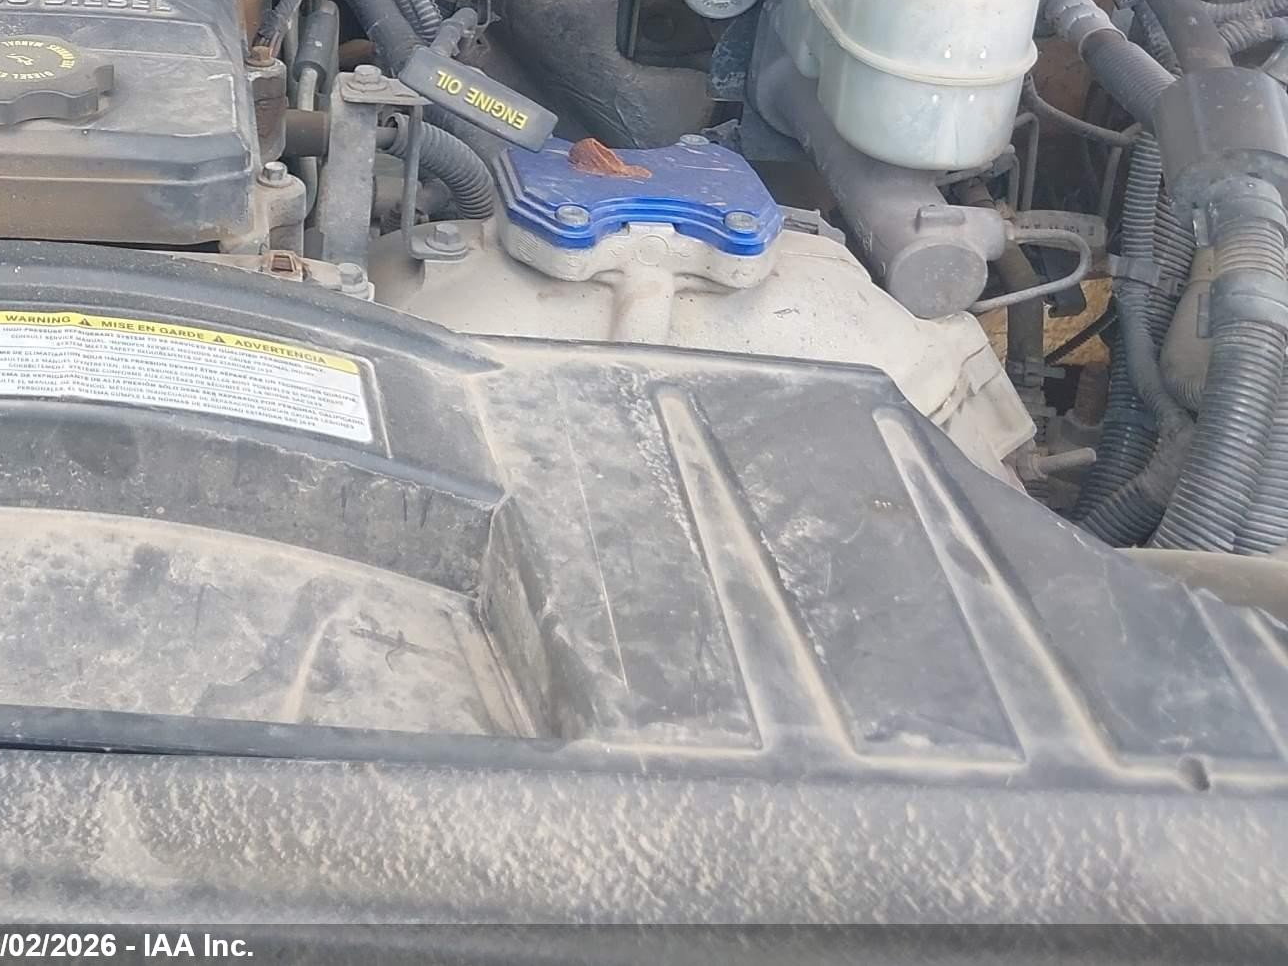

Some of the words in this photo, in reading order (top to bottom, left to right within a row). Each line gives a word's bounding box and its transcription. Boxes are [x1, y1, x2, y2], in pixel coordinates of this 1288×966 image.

[0, 40, 45, 48] MANUAL
[12, 70, 55, 80] DIESEL
[436, 69, 463, 95] OIL
[463, 87, 529, 130] ENGINE
[5, 315, 71, 324] WARNING
[101, 321, 135, 331] MISE
[138, 324, 155, 333] EN
[159, 327, 204, 339] GARDE
[234, 340, 327, 364] ADVERTENCIA
